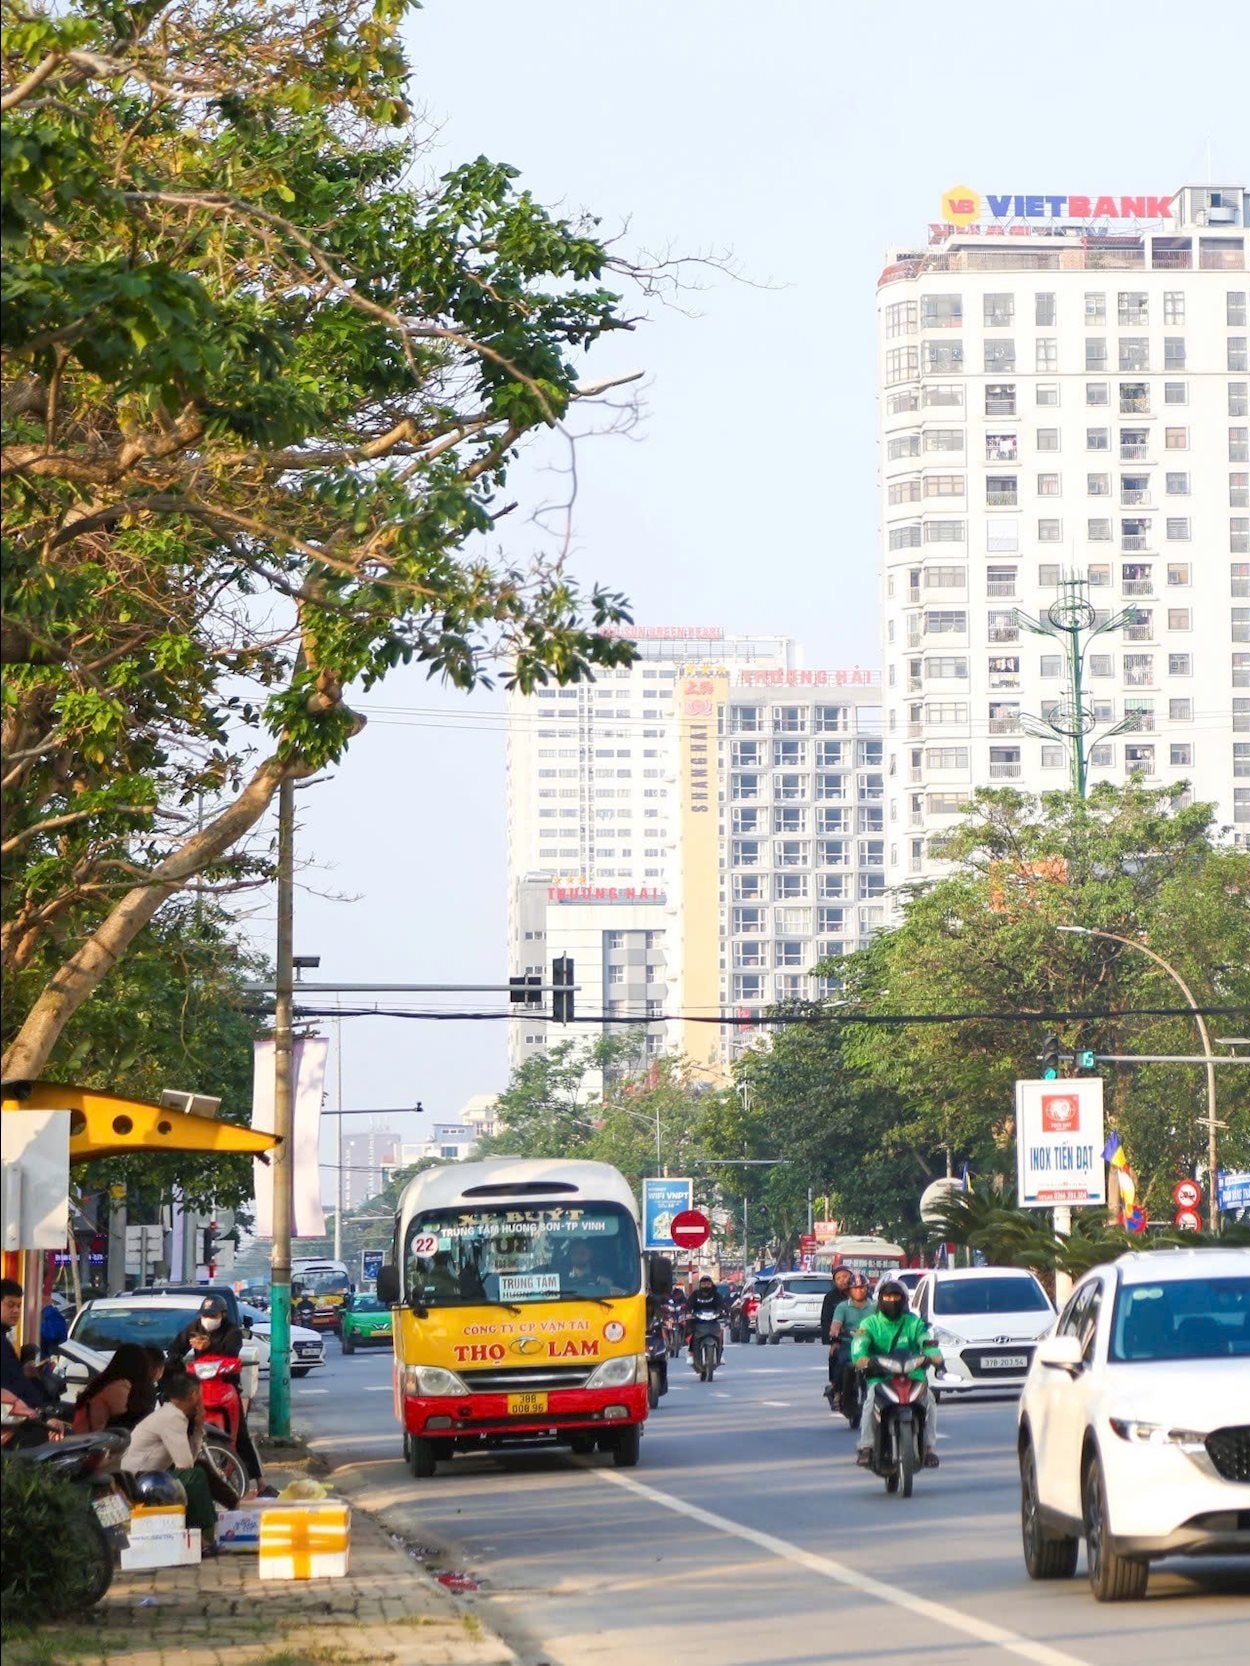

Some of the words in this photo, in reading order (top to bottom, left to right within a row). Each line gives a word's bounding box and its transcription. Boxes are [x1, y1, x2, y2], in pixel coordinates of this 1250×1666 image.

[949, 199, 974, 214] VB
[986, 195, 1174, 218] VIETBANK
[690, 725, 709, 813] SHANGHAI
[1030, 1146, 1052, 1171] INOX
[1054, 1140, 1074, 1171] TIẾN
[1076, 1145, 1094, 1175] ĐẠT
[666, 1191, 689, 1199] VNPT
[506, 1208, 584, 1223] BUÝT
[441, 1227, 475, 1238] TRUNG
[582, 1221, 605, 1231] VINH
[416, 1238, 434, 1252] 22
[502, 1278, 534, 1290] TRUNG
[501, 1323, 515, 1333] TY
[520, 1322, 536, 1332] CP
[454, 1342, 506, 1364] THỌ
[548, 1339, 600, 1357] LAM
[519, 1394, 537, 1403] 38B
